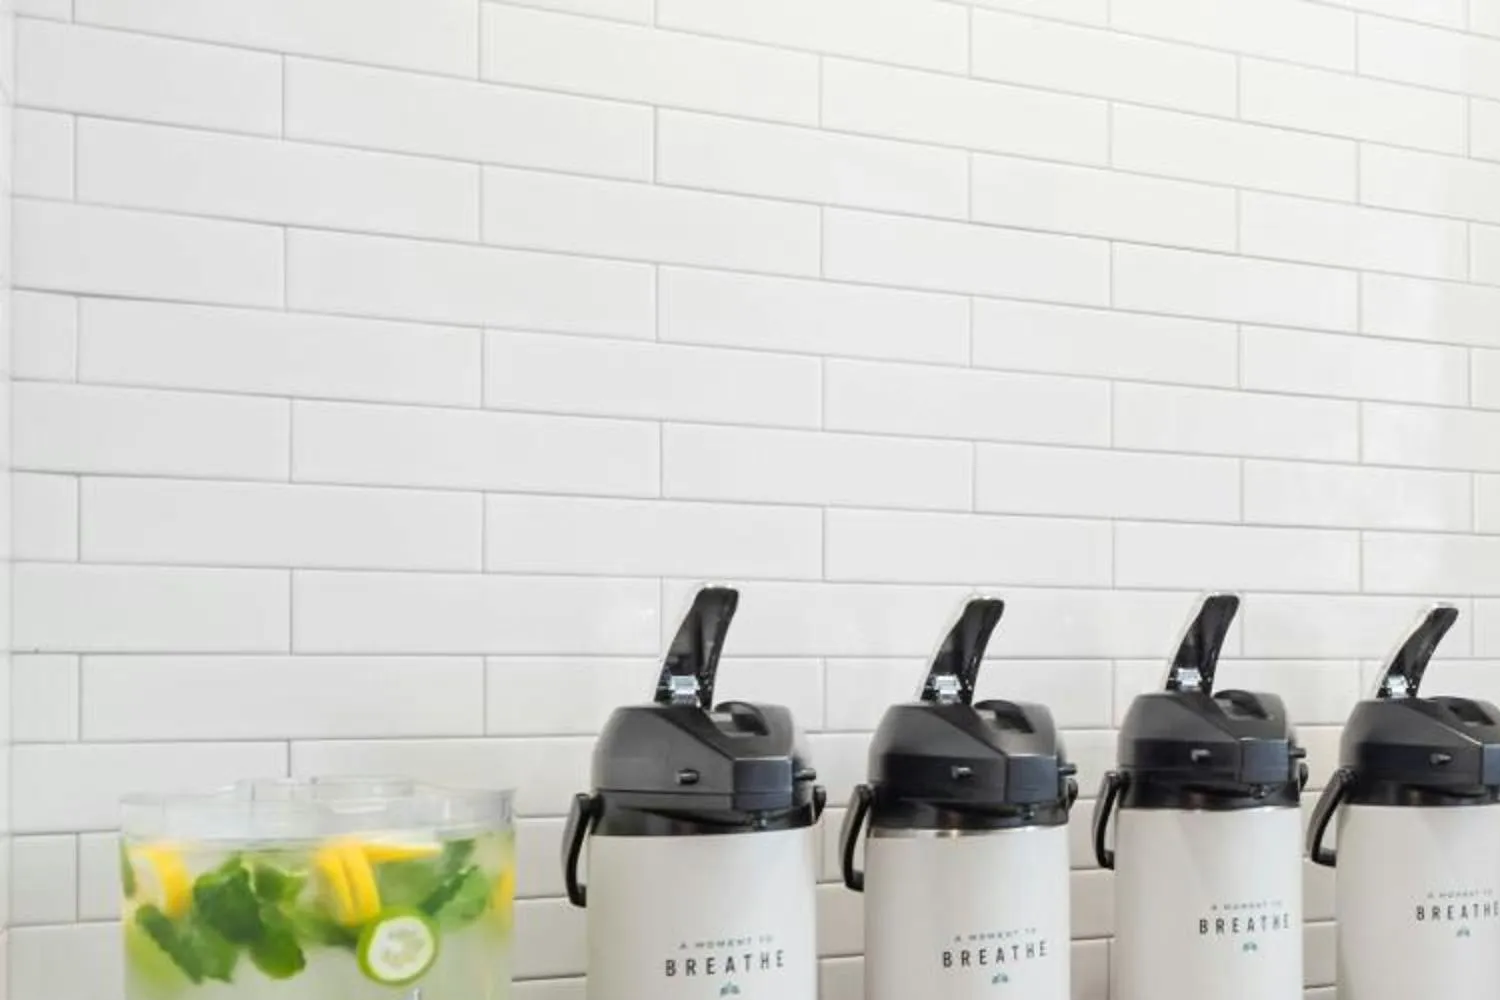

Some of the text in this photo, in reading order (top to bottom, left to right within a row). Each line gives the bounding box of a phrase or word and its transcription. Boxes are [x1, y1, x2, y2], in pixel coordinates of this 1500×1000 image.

[1199, 912, 1290, 934] BREATHE
[1416, 901, 1499, 921] BREATHE
[665, 949, 785, 977] BREATHE
[943, 940, 1047, 968] BREATHE
